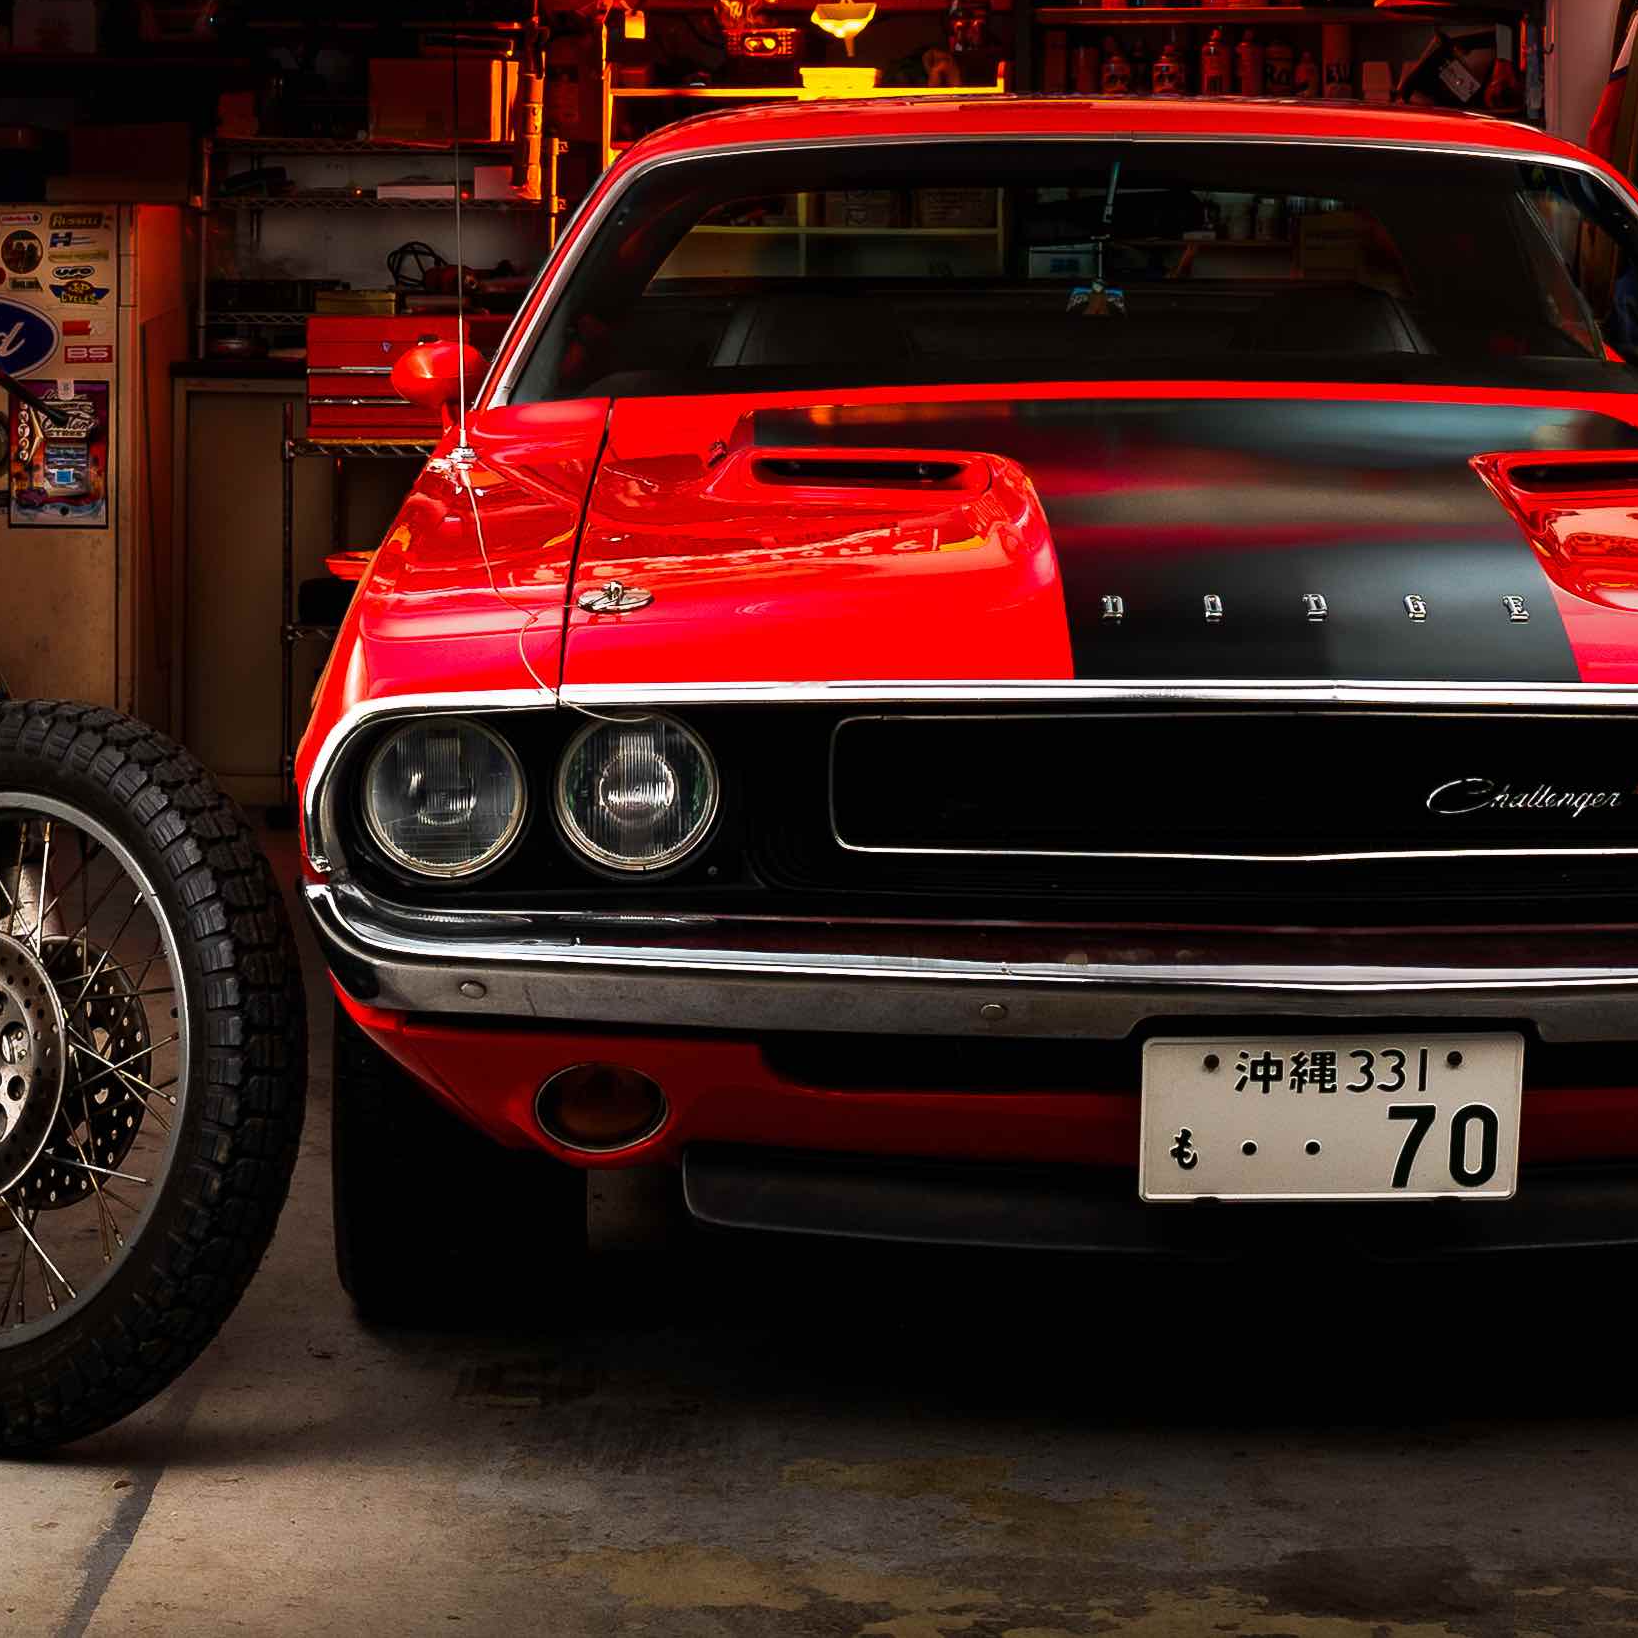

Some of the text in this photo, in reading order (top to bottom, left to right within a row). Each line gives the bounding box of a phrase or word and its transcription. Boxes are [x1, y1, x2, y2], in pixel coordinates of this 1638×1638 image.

[67, 347, 109, 359] BS
[1099, 593, 1531, 624] DODGE
[1425, 777, 1625, 819] Challenger
[1234, 1047, 1429, 1095] 沖縄 331
[1169, 1102, 1500, 1189] も 70
